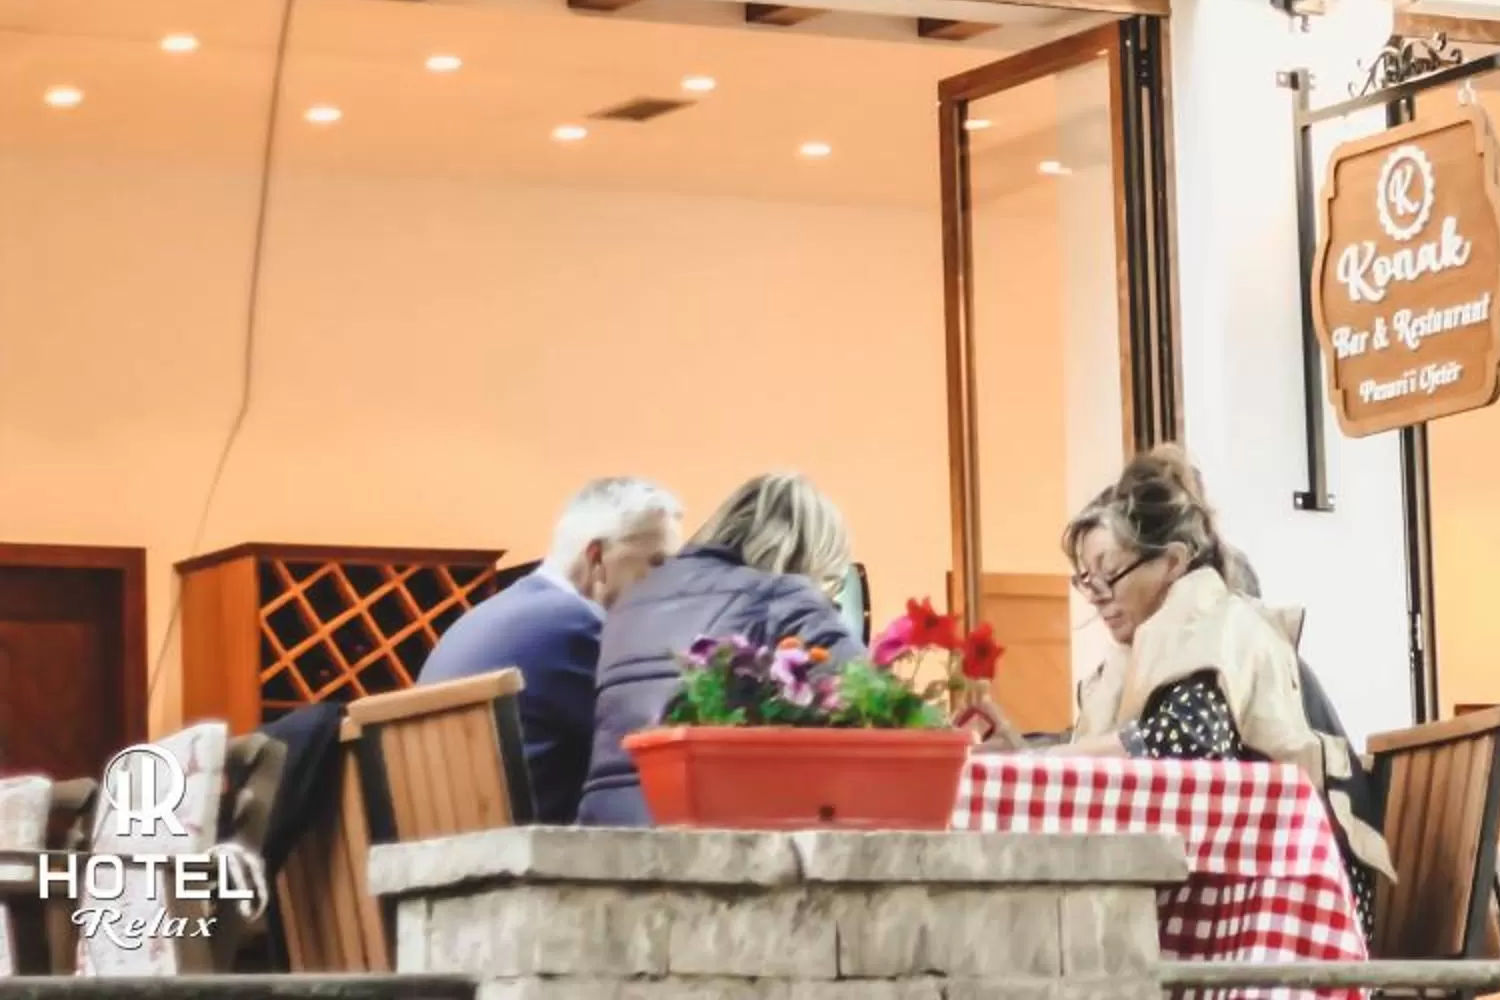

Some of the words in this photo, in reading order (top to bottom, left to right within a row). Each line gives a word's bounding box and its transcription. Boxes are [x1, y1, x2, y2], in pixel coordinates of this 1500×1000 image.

[1336, 215, 1472, 302] Konak
[1332, 325, 1370, 360] Bar
[1373, 316, 1390, 351] &
[1393, 291, 1491, 351] Restaurant
